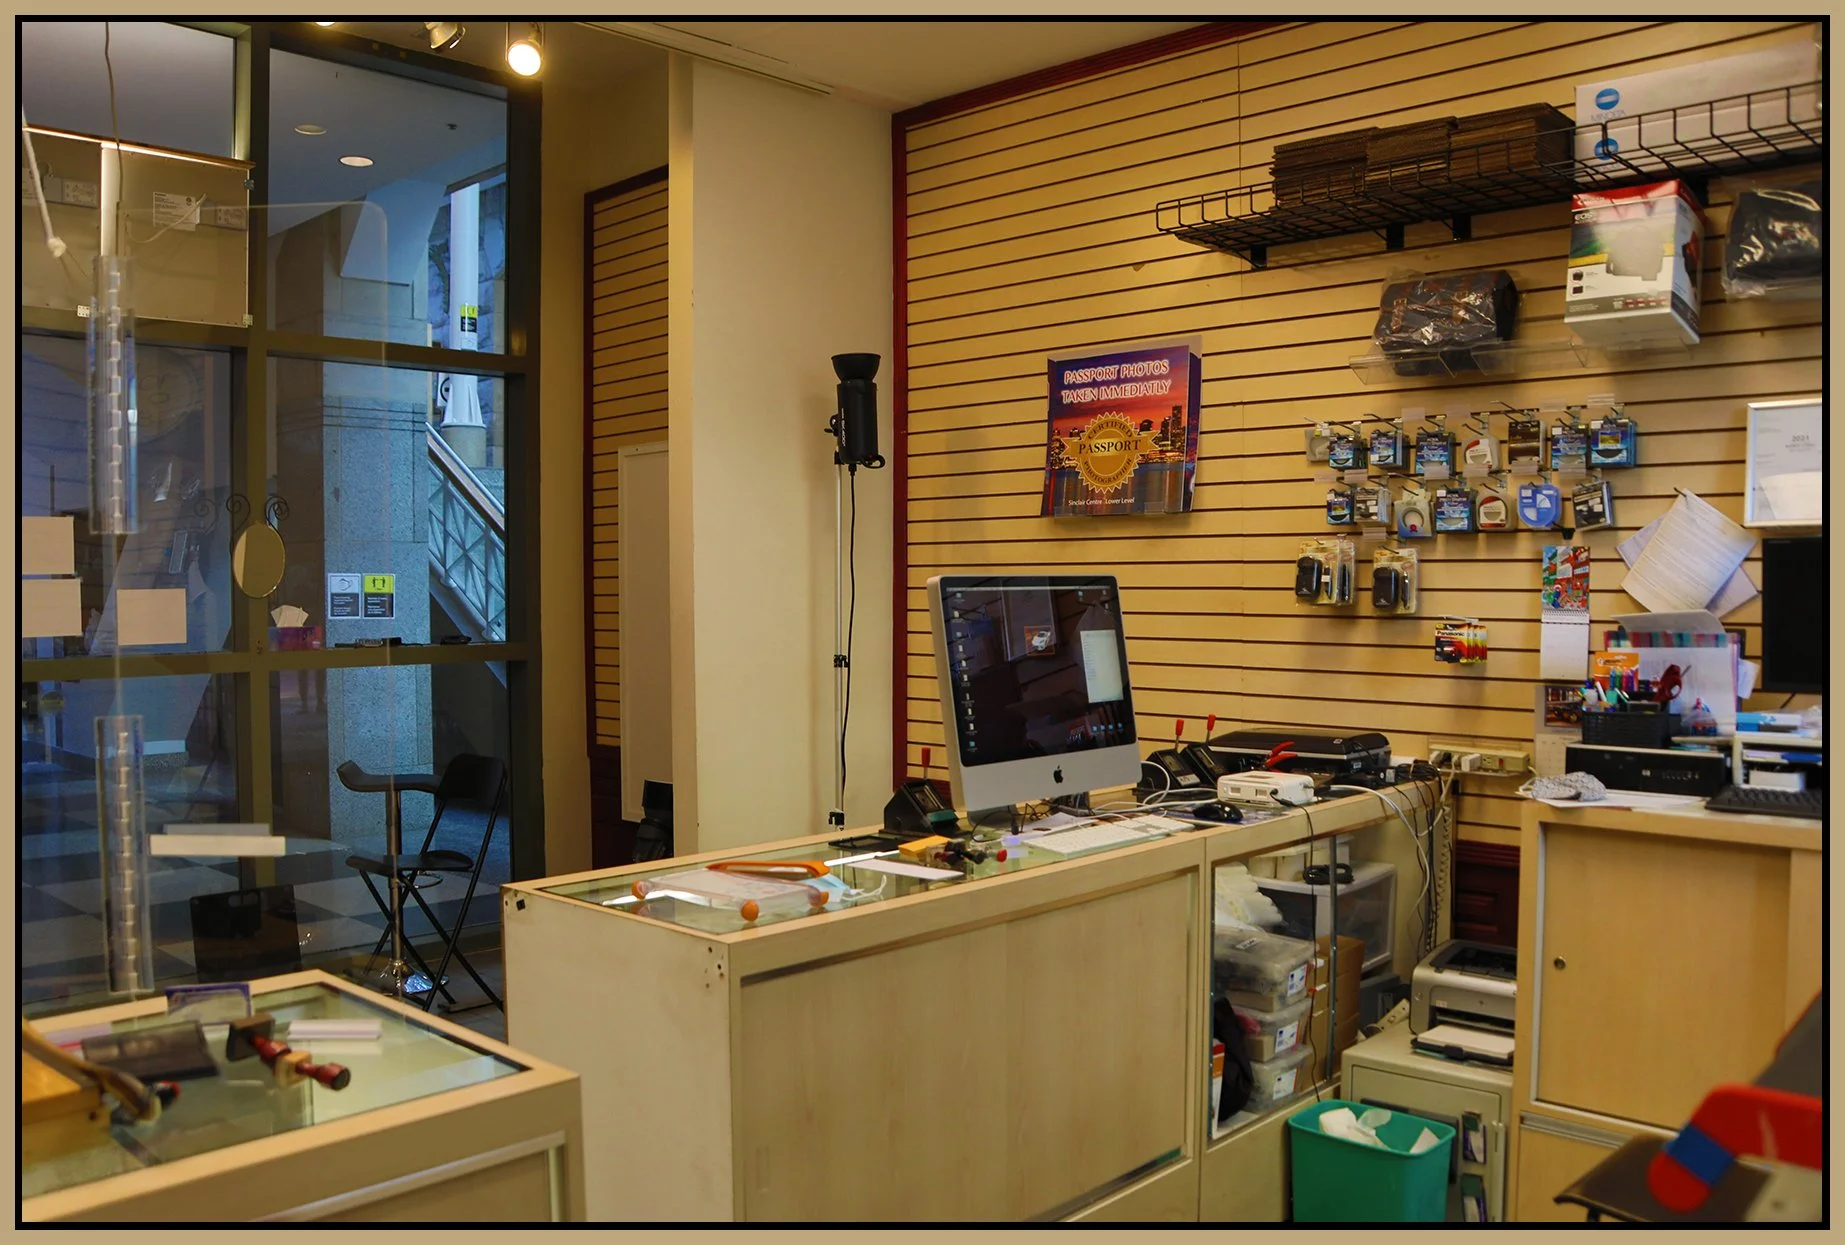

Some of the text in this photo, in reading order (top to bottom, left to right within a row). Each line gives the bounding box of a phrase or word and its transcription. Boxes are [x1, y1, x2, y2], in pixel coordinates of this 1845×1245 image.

[1064, 359, 1170, 385] PASSPORT PHOTOS
[1061, 378, 1173, 404] TAKEN IMMEDIATLY
[1088, 420, 1134, 440] CERTIFIED
[1079, 439, 1141, 455] PASSPORT
[1084, 457, 1133, 484] PHOTOGRAPHER
